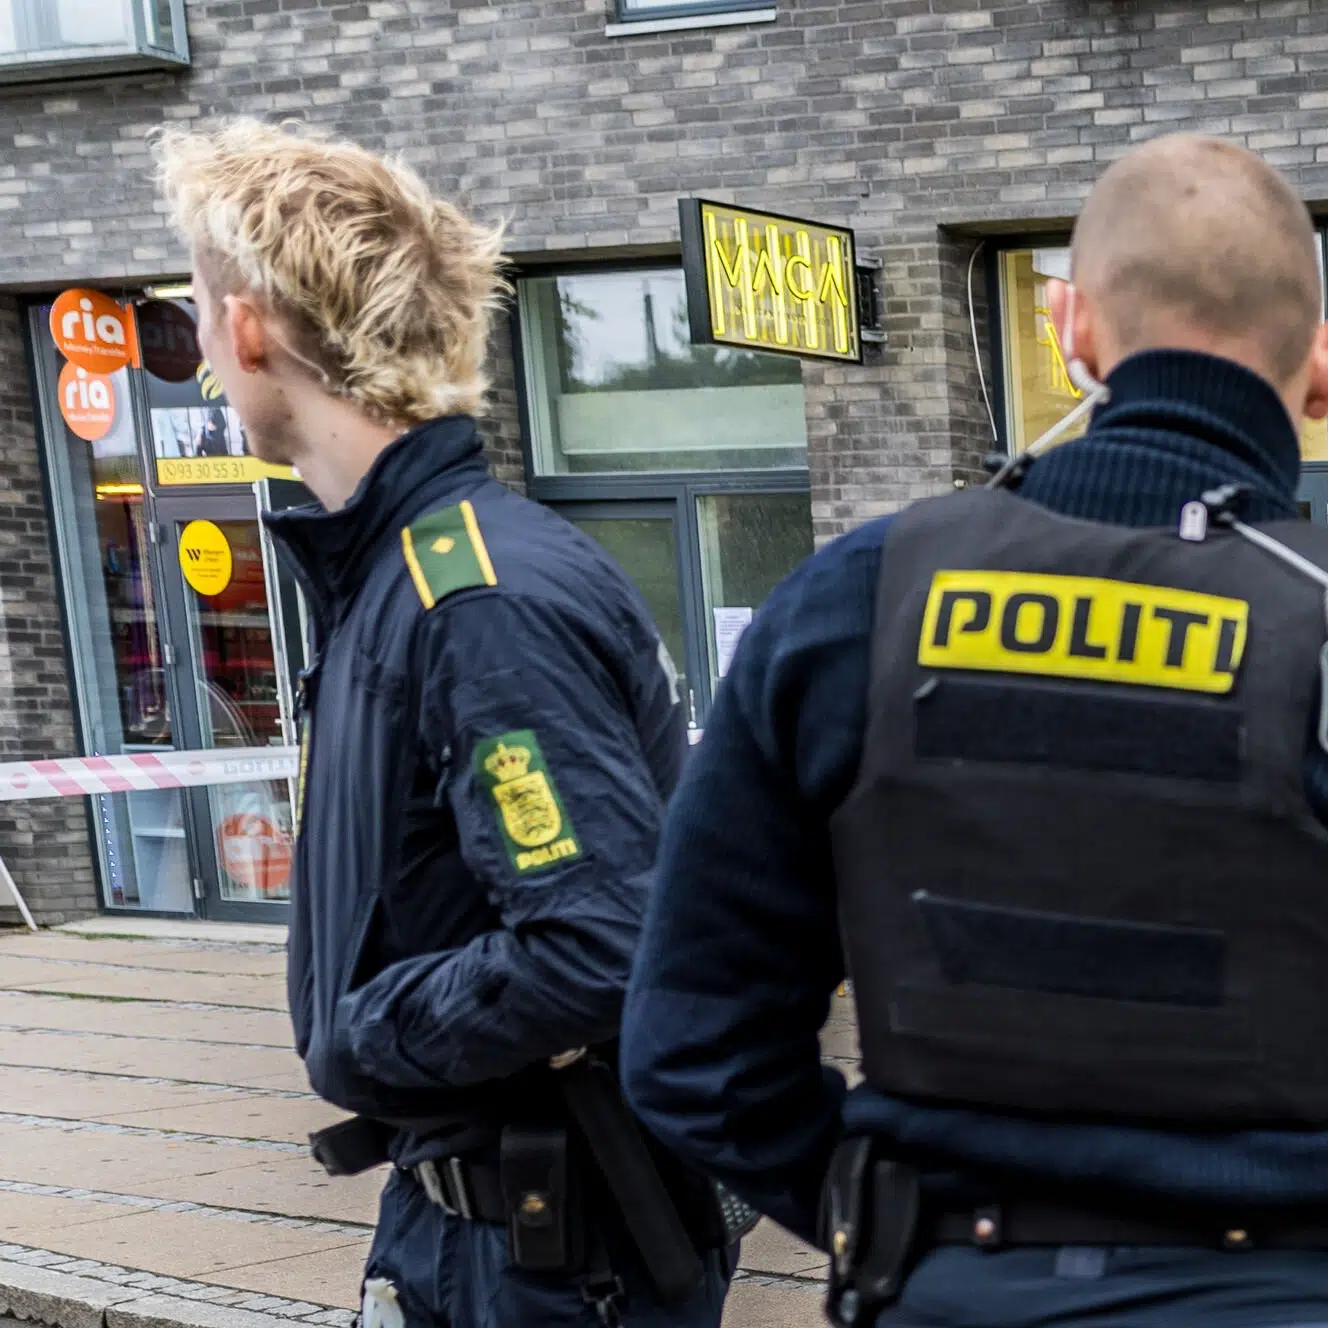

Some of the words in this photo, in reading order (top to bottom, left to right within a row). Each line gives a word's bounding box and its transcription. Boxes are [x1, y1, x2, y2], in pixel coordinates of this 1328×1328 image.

[714, 239, 848, 307] VACA
[62, 298, 126, 345] ria
[65, 366, 110, 409] ria
[213, 463, 228, 478] 55
[931, 590, 1238, 674] POLITI
